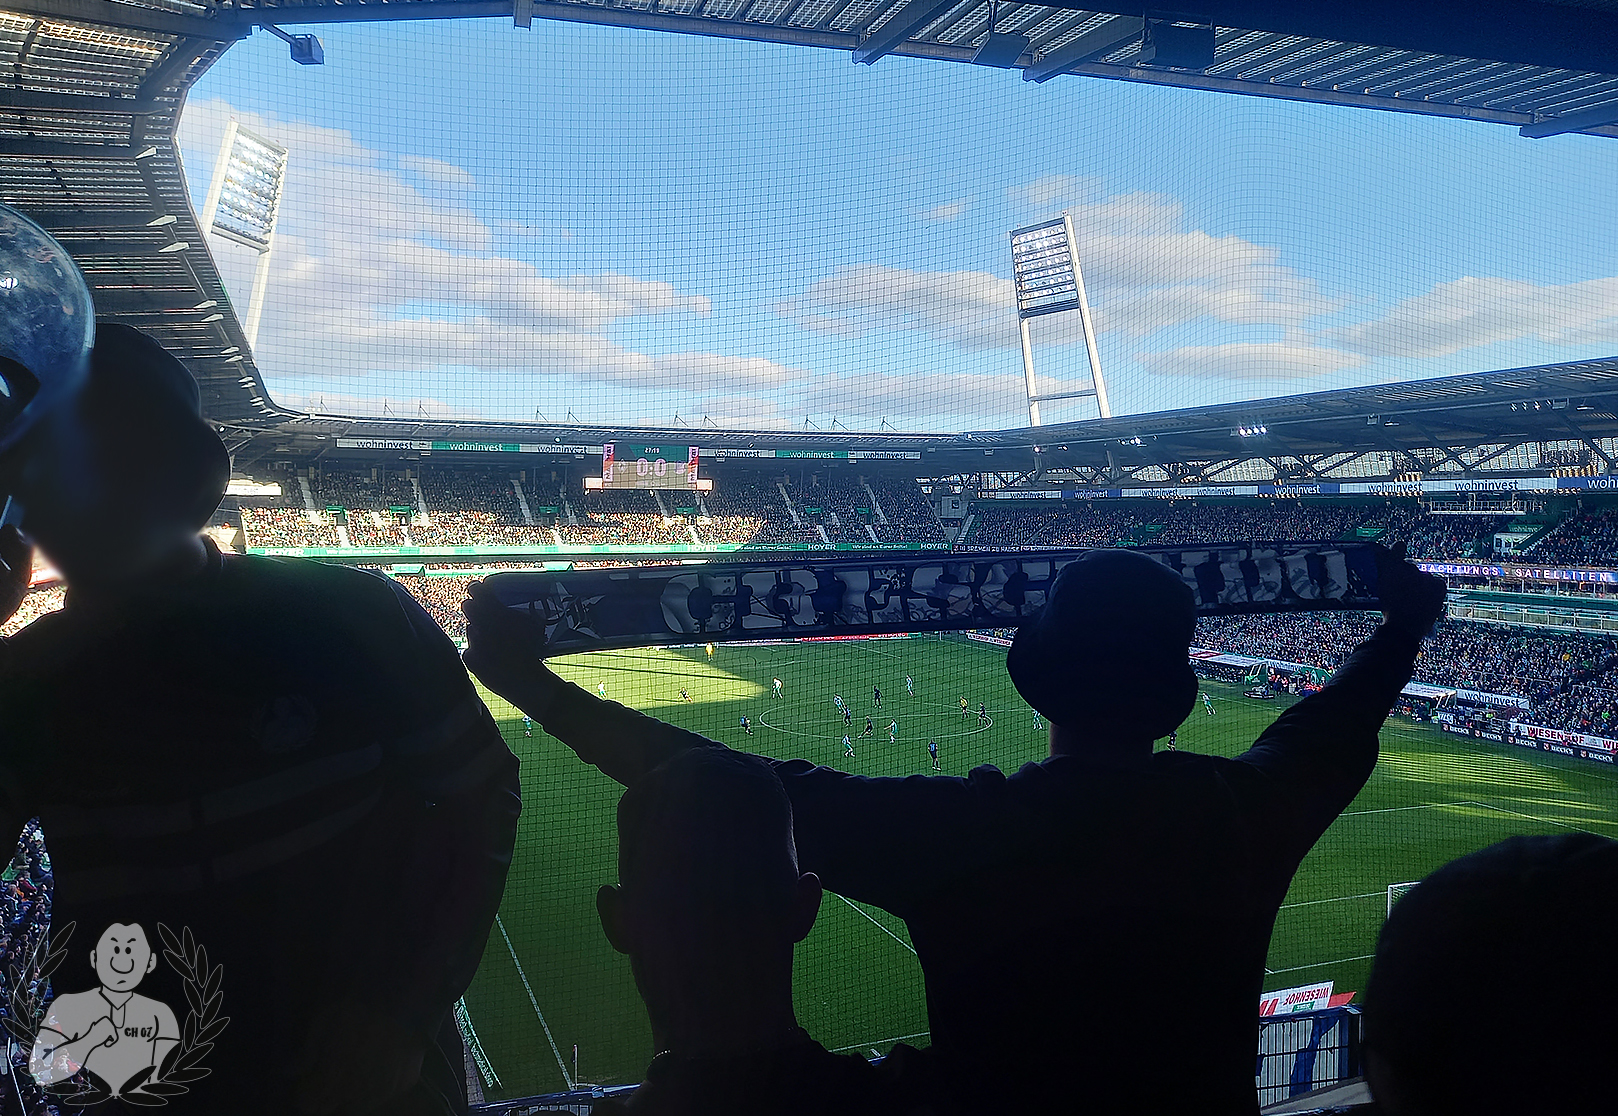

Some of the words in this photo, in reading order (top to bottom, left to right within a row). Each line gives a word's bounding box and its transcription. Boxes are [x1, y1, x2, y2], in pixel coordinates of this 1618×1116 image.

[356, 439, 413, 450] wohninvest
[449, 441, 503, 452] wohninvest
[537, 444, 588, 454] wohninvest
[715, 448, 761, 458] wohninvest
[789, 450, 835, 459] wohninvest
[863, 451, 907, 460] wohninvest
[636, 457, 667, 477] 0:0
[1273, 484, 1321, 495] wohninvest
[1367, 481, 1423, 493] wohninvest
[1455, 479, 1519, 491] wohninvest
[1010, 490, 1047, 499] wohninvest
[1074, 489, 1109, 499] wohninvest
[1418, 563, 1500, 577] BACHTUNGS
[1515, 568, 1608, 582] SATELLITEN
[1464, 691, 1520, 707] wohninvest
[1527, 726, 1586, 745] WIESENHOF
[1282, 987, 1331, 1007] WIESENHOF
